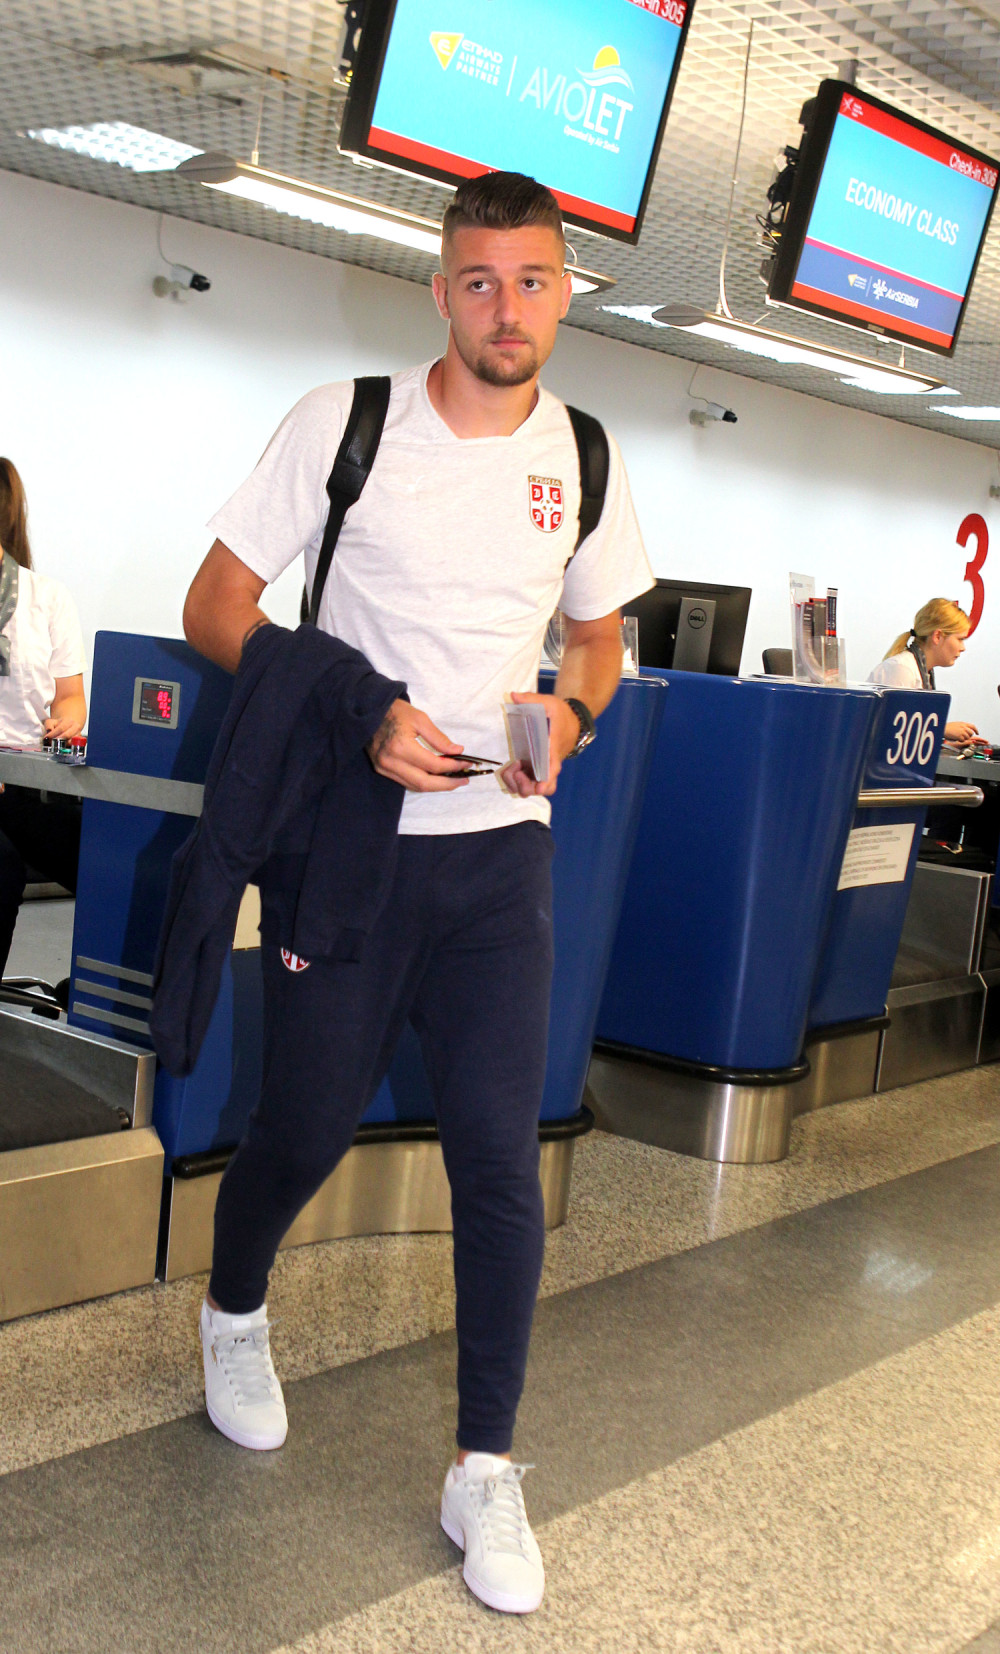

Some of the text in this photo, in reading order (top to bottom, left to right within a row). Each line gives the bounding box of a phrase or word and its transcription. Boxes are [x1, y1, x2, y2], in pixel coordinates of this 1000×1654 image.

[661, 0, 686, 24] 305
[458, 51, 501, 75] AIRWAYS
[461, 39, 504, 64] ETIHAD
[456, 61, 499, 87] PARTNER
[518, 66, 634, 141] AVIOLET
[949, 152, 998, 188] Check-in 306
[845, 177, 960, 246] ECONOMY CLASS
[954, 513, 989, 640] 3
[886, 710, 939, 765] 306
